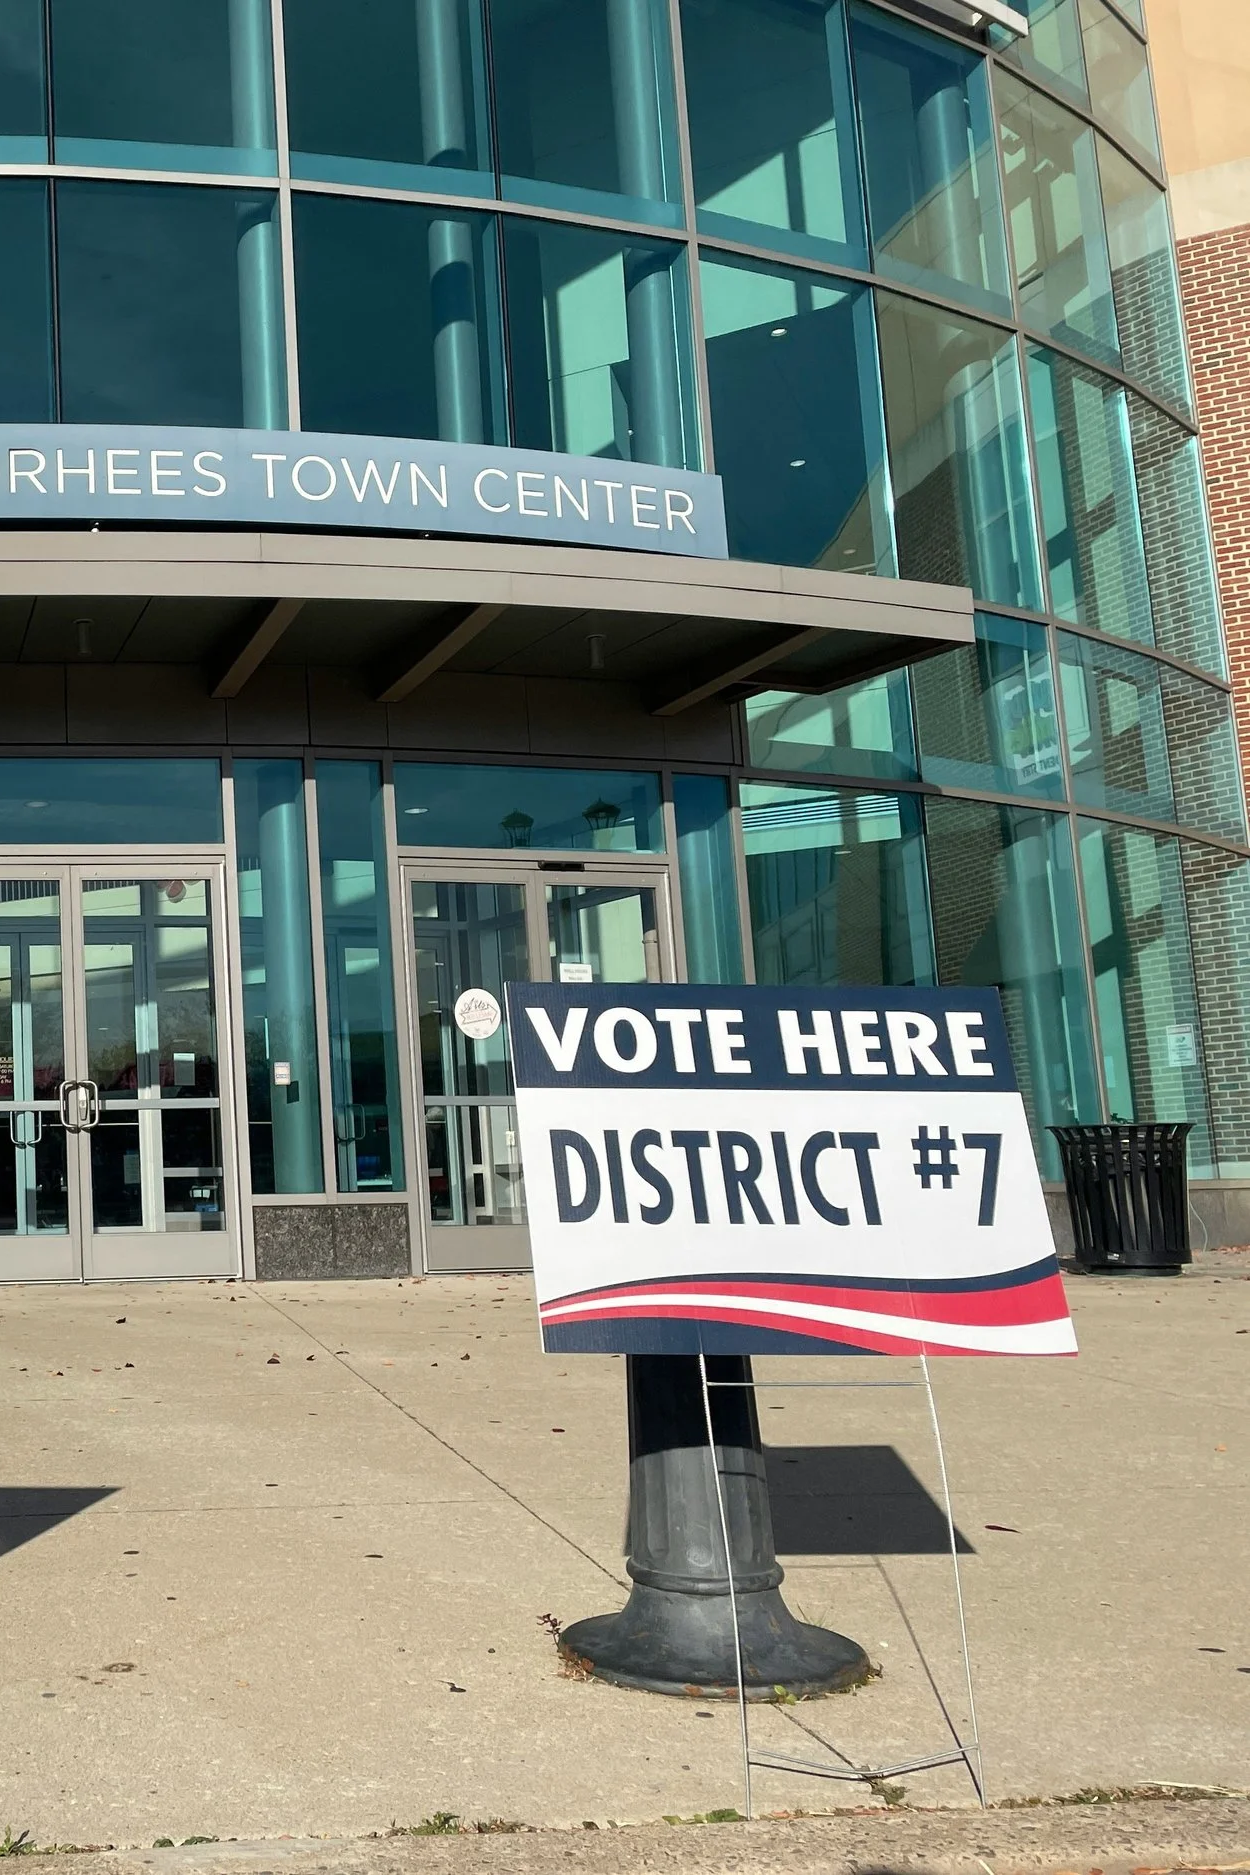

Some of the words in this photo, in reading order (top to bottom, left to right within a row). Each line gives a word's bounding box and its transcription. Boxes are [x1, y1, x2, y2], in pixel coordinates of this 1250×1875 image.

[251, 453, 448, 509] TOWN
[473, 467, 697, 535] CENTER
[524, 1006, 752, 1074] VOTE
[777, 1009, 995, 1077] HERE
[549, 1128, 883, 1226] DISTRICT
[911, 1125, 1003, 1227] #7
